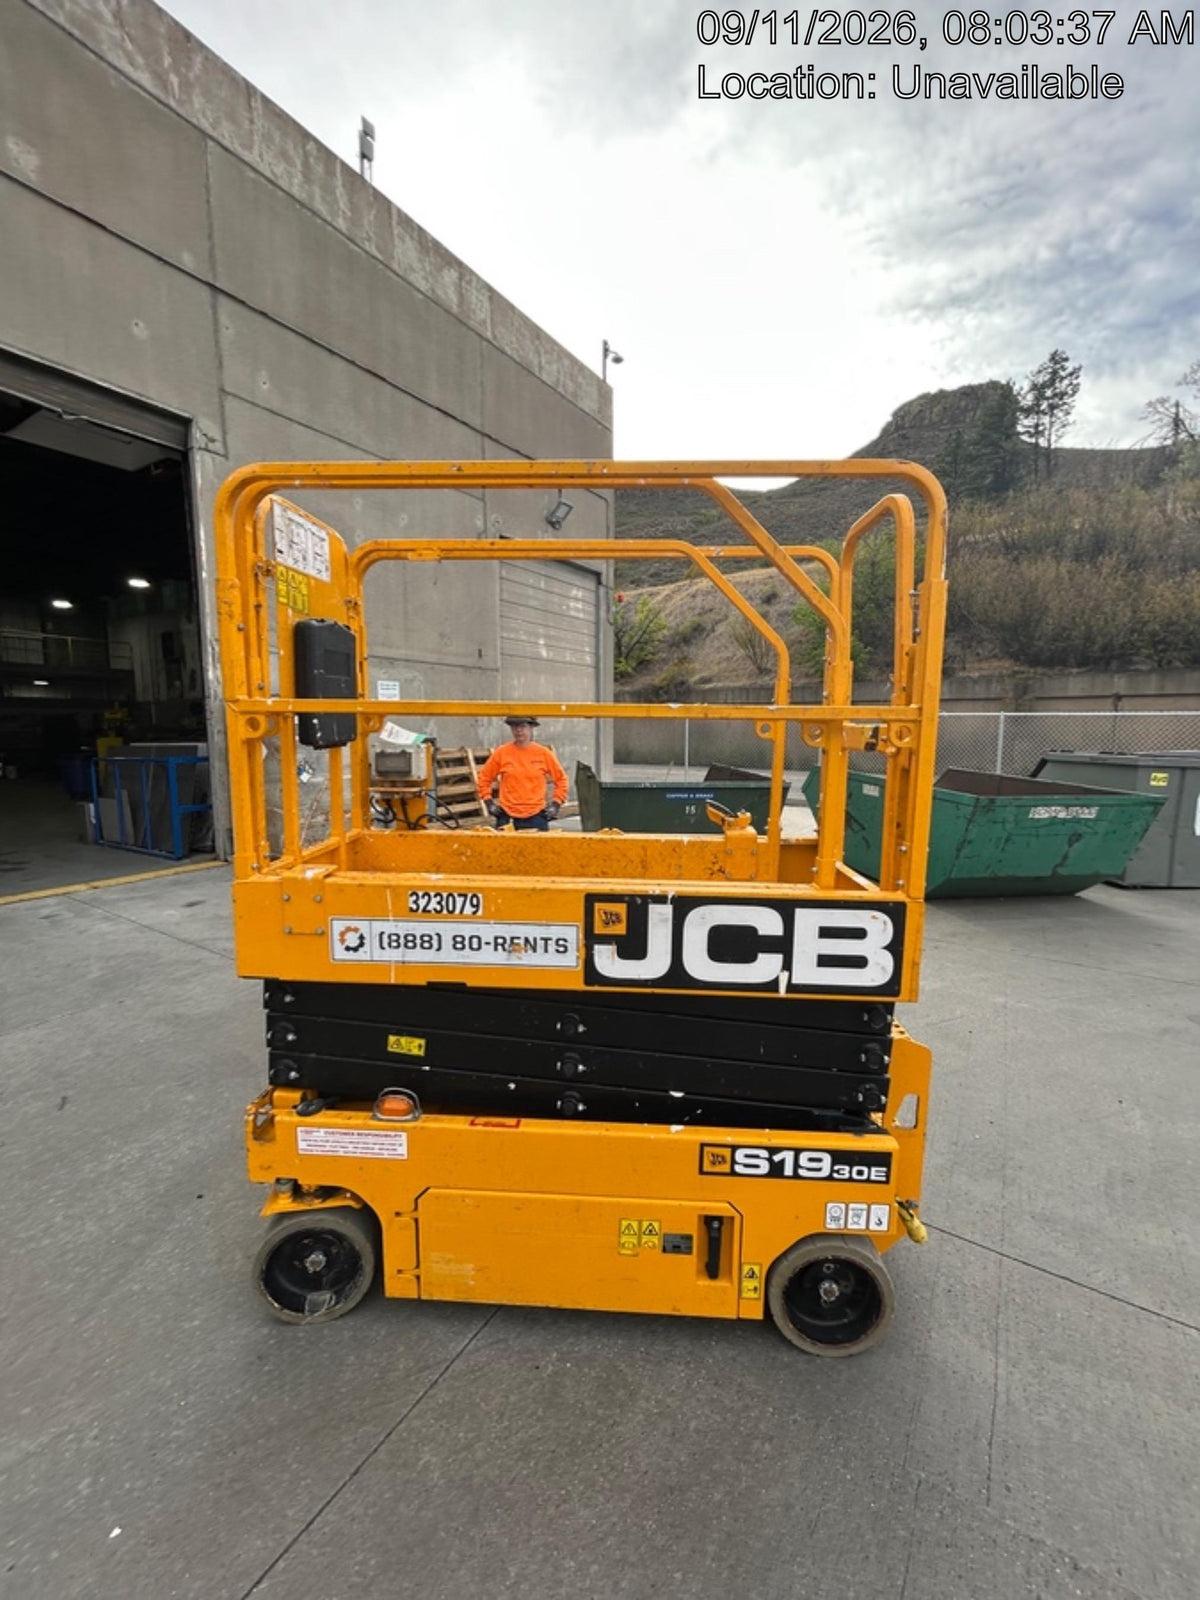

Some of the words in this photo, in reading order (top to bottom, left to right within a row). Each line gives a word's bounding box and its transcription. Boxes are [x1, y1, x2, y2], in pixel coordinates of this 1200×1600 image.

[408, 891, 482, 915] 323079
[378, 930, 443, 952] (888)
[452, 933, 569, 955] 80-RENTS
[593, 904, 895, 987] JCB
